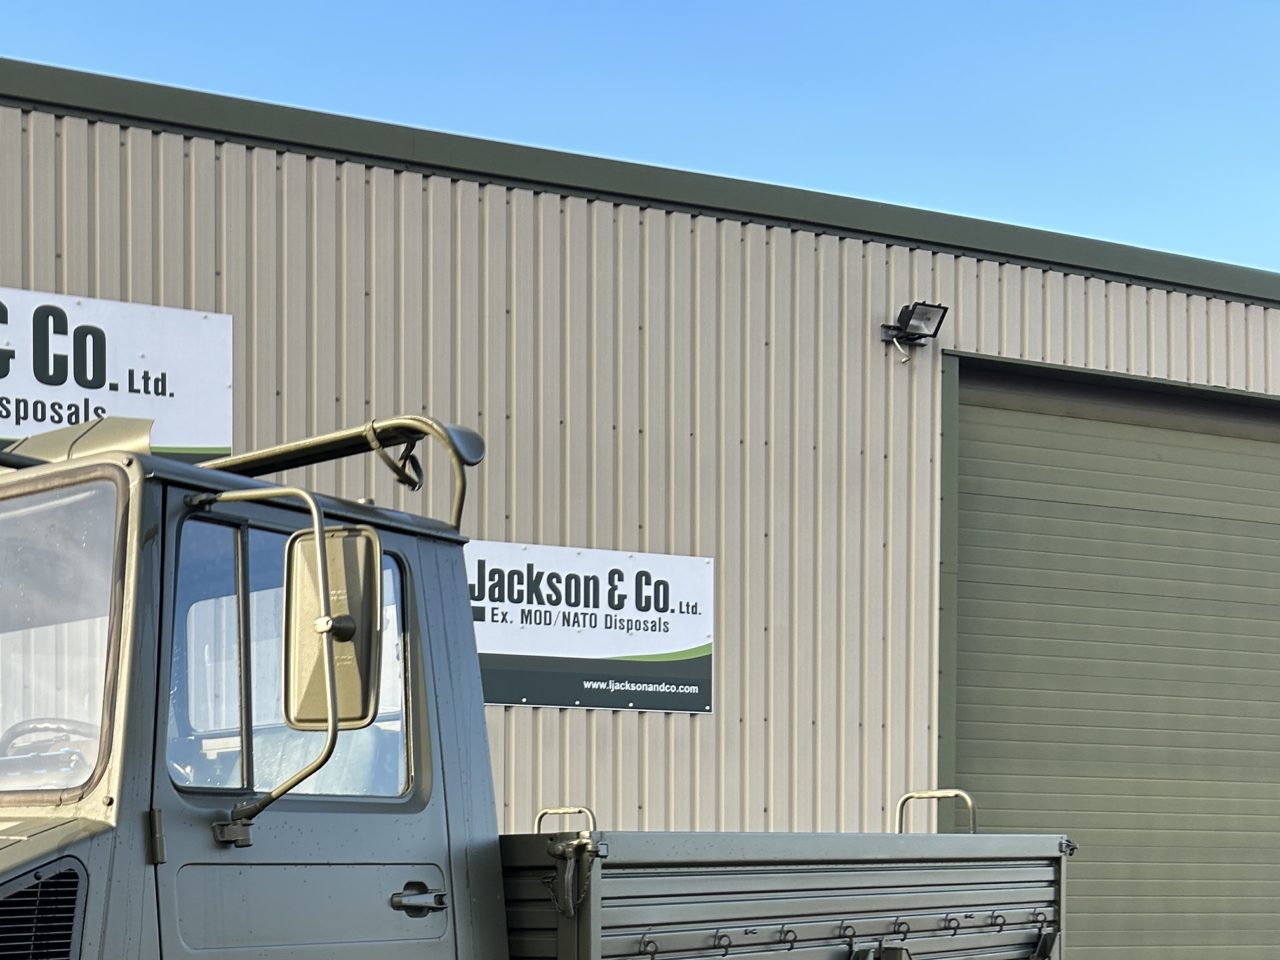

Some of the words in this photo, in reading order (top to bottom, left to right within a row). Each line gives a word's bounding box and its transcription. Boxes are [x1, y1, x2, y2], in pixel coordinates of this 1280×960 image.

[32, 305, 119, 391] Co.
[128, 368, 175, 398] Ltd.
[469, 559, 600, 622] Jackson
[607, 568, 628, 611] &
[634, 570, 676, 614] Co.
[679, 600, 703, 616] Ltd.
[490, 606, 514, 625] Ex.
[520, 608, 598, 629] MOD/NATO
[604, 613, 670, 634] Disposals
[582, 679, 699, 694] www.ljacksonandco.com
